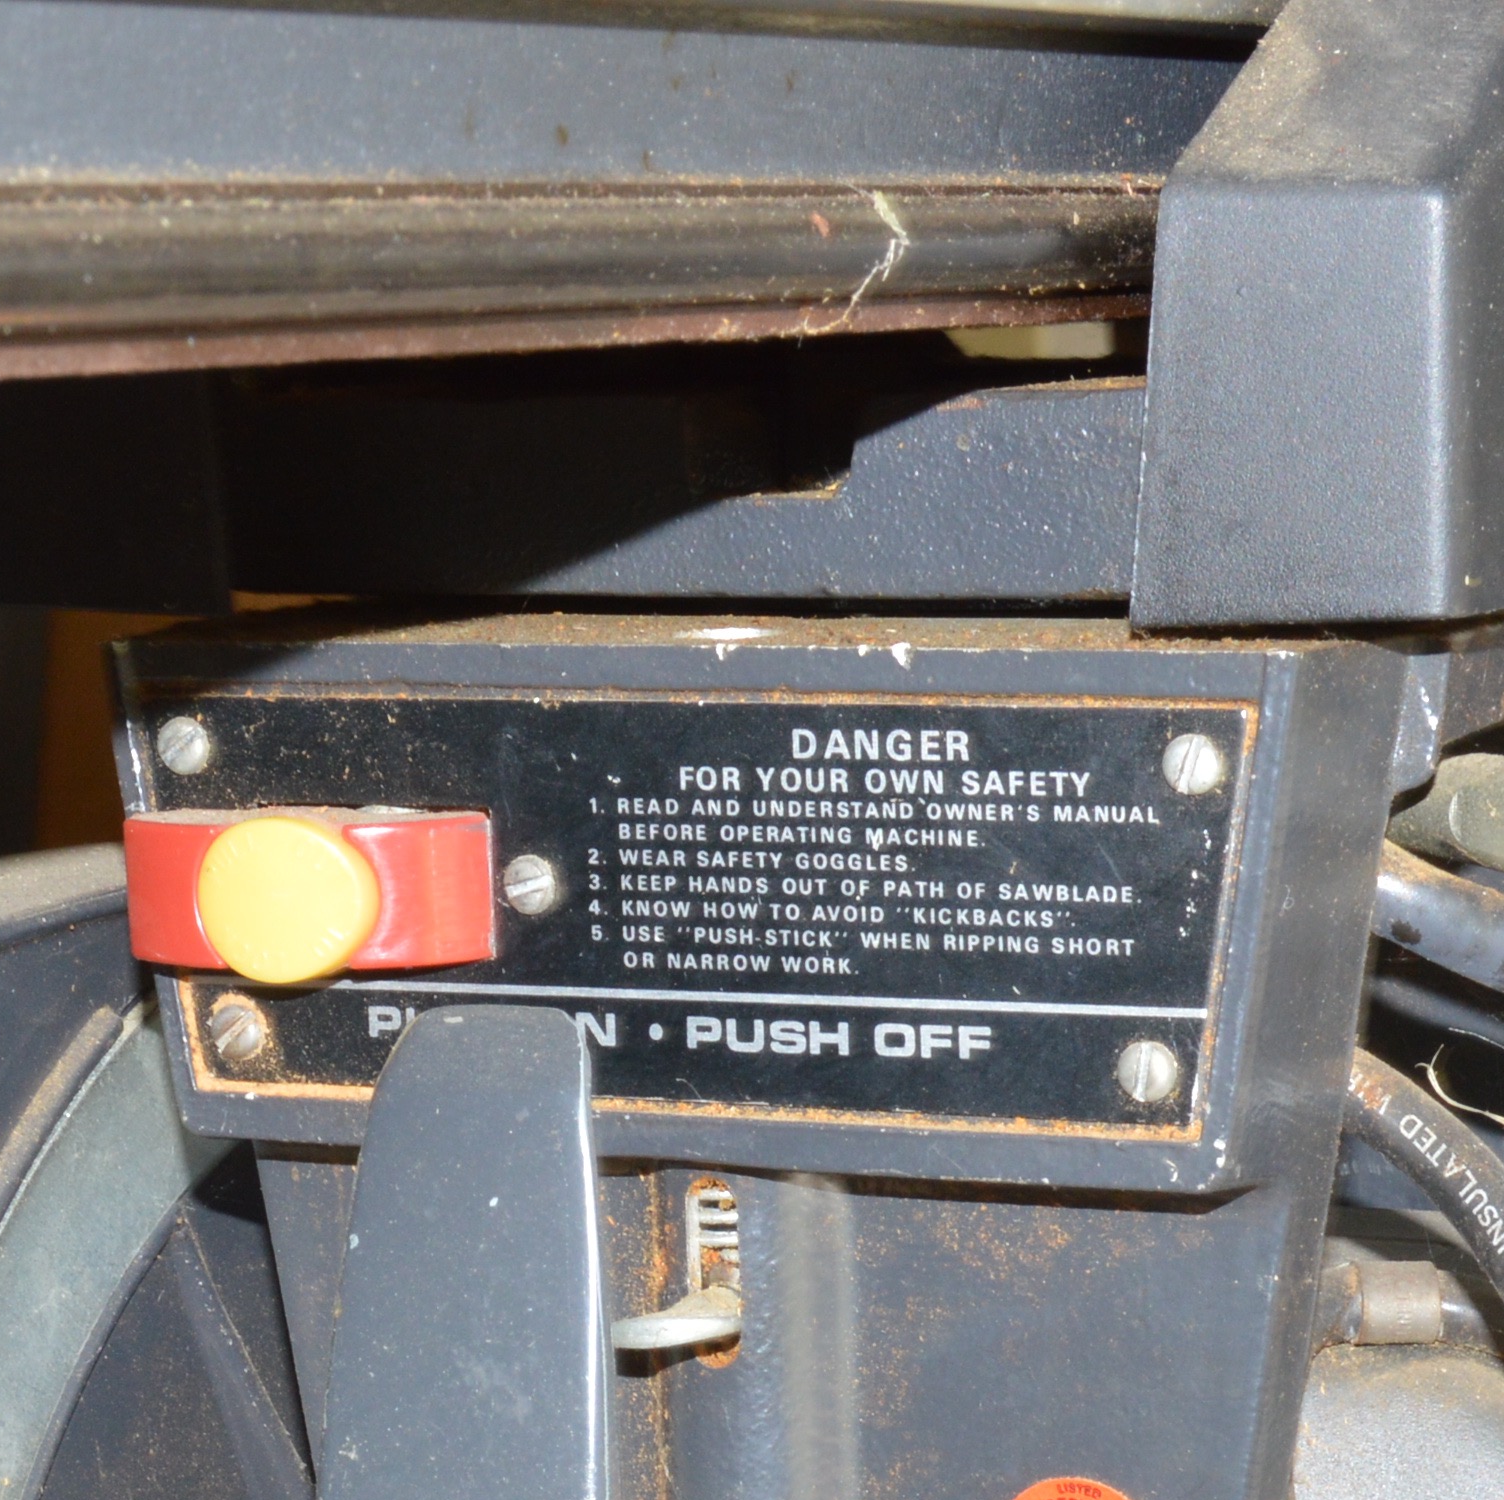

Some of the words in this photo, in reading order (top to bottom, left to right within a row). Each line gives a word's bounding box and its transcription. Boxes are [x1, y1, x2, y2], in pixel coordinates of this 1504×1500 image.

[791, 728, 971, 762] DANGER
[679, 766, 741, 791] FOR
[756, 767, 849, 793] YOUR
[864, 768, 944, 795] OWN
[961, 770, 1090, 797] SAFETY
[589, 798, 605, 814] 1.
[617, 798, 679, 815] READ
[691, 799, 740, 816] AND
[752, 800, 914, 820] UNDERSTAND
[926, 802, 1041, 822] OWNER'S
[1053, 806, 1160, 824] MANUAL
[618, 824, 707, 841] BEFORE
[720, 825, 852, 844] OPERATING
[865, 828, 986, 848] MACHINE.
[587, 848, 607, 865] 2.
[619, 849, 686, 866] WEAR
[697, 850, 783, 868] SAFETY
[795, 852, 916, 871] GOGGLES.
[589, 874, 607, 891] 3.
[621, 874, 677, 892] KEEP
[688, 876, 769, 894] HANDS
[782, 878, 827, 896] OUT
[841, 879, 870, 897] OF
[883, 880, 944, 898] PATH
[957, 882, 986, 899] OF
[998, 883, 1142, 904] SAWBLADE.
[589, 899, 608, 916] 4.
[622, 900, 691, 917] KNOW
[703, 901, 758, 919] HOW
[769, 903, 800, 921] TO
[812, 904, 885, 923] AVOID
[591, 925, 609, 942] 5.
[622, 925, 665, 942] USE
[861, 932, 930, 950] WHEN
[943, 934, 1040, 953] RIPPING
[1051, 936, 1135, 956] SHORT
[623, 951, 655, 968] OR
[667, 952, 771, 972] NARROW
[781, 955, 860, 975] WORK.
[575, 1011, 616, 1047] N
[686, 1015, 850, 1056] PUSH
[873, 1022, 993, 1059] OFF
[1056, 1482, 1103, 1500] LISTED
